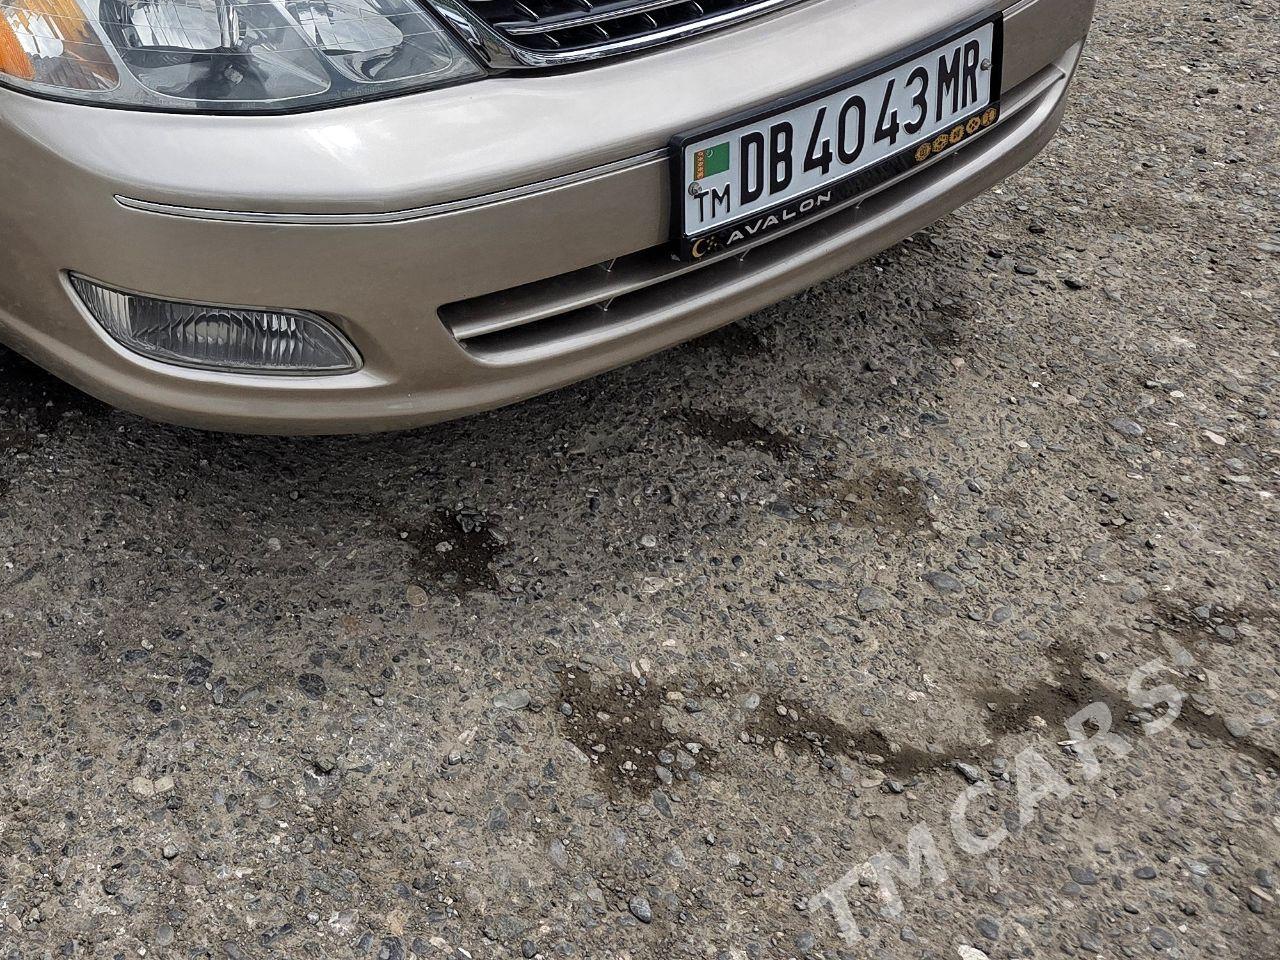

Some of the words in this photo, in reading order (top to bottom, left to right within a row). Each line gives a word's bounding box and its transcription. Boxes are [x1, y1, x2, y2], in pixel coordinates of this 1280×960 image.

[739, 39, 981, 207] DB4043MR
[694, 183, 731, 222] TM
[726, 190, 832, 245] AVALON
